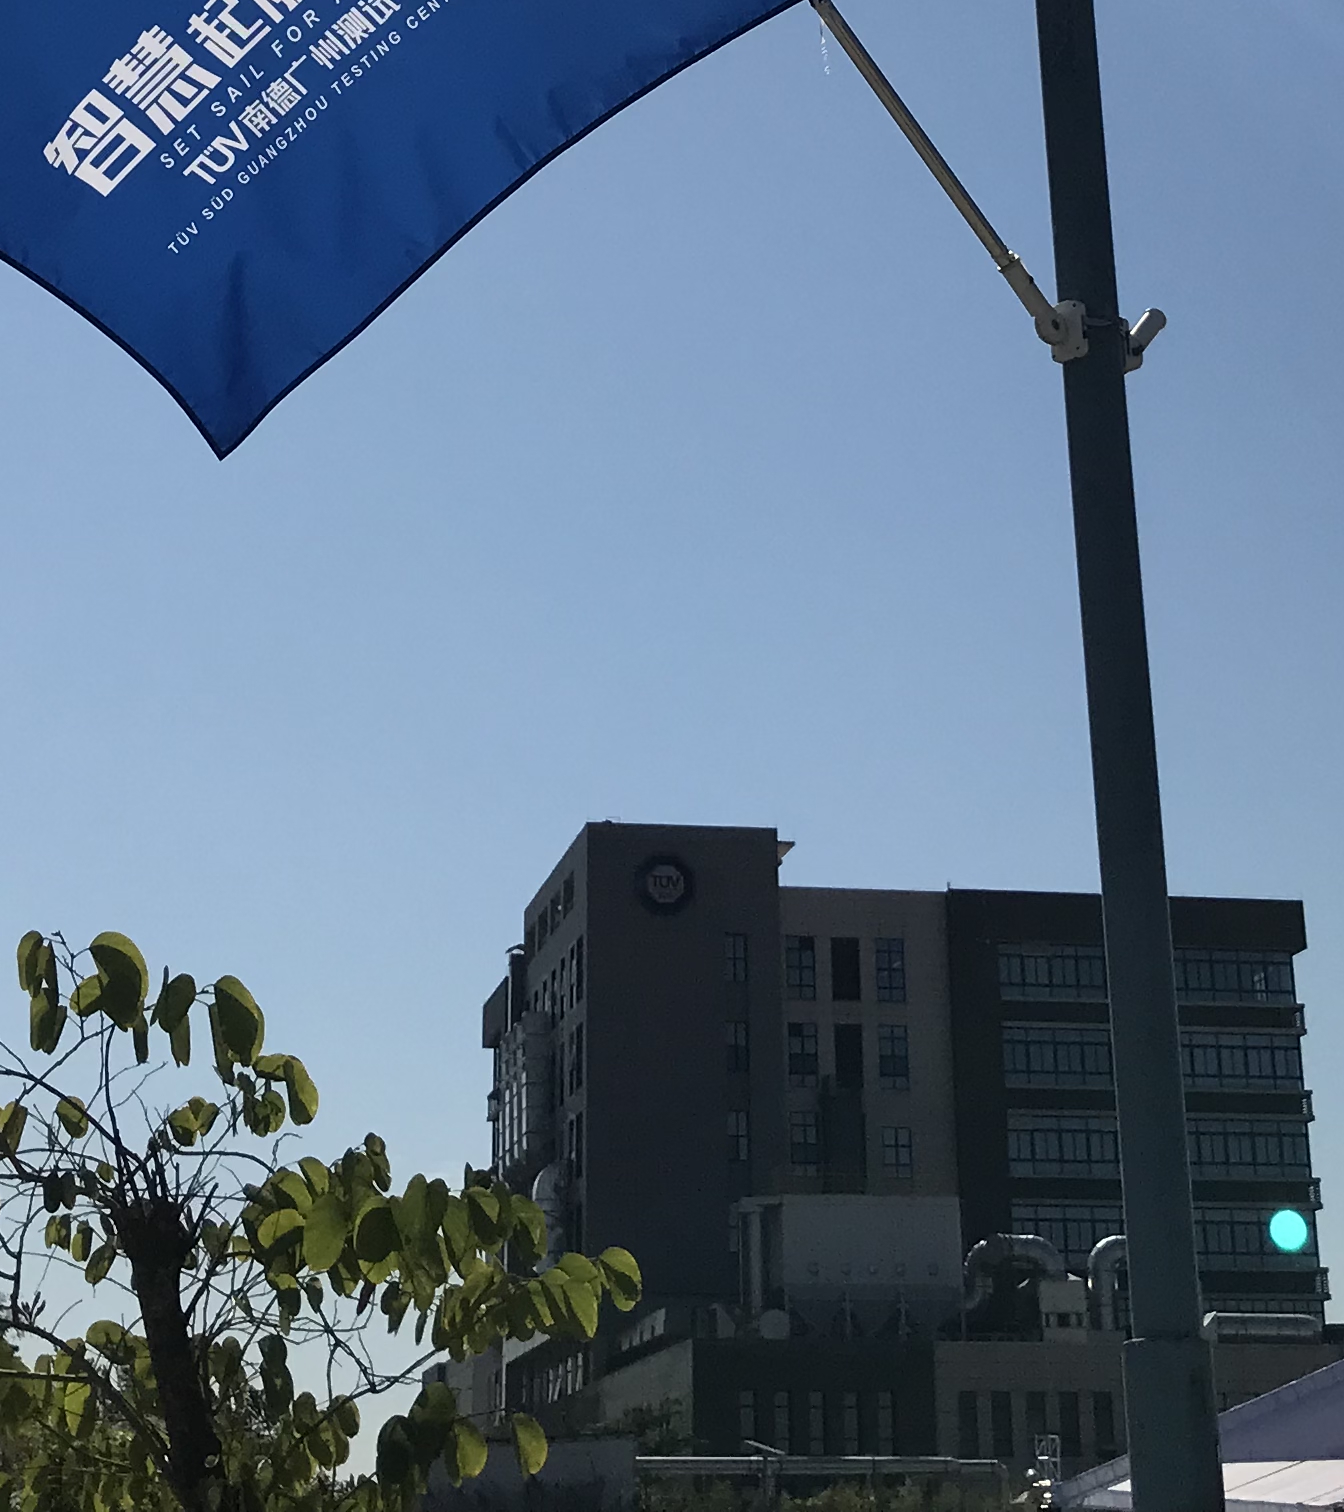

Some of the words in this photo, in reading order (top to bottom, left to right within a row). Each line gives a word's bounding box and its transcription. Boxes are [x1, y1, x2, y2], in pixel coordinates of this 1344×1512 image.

[159, 124, 202, 169] SET
[210, 64, 265, 117] SAIL
[271, 9, 321, 59] FOR
[167, 222, 199, 255] TÜV
[201, 188, 234, 220] SÜD
[237, 94, 329, 185] GUANGZHOU
[330, 31, 402, 95] TESTING
